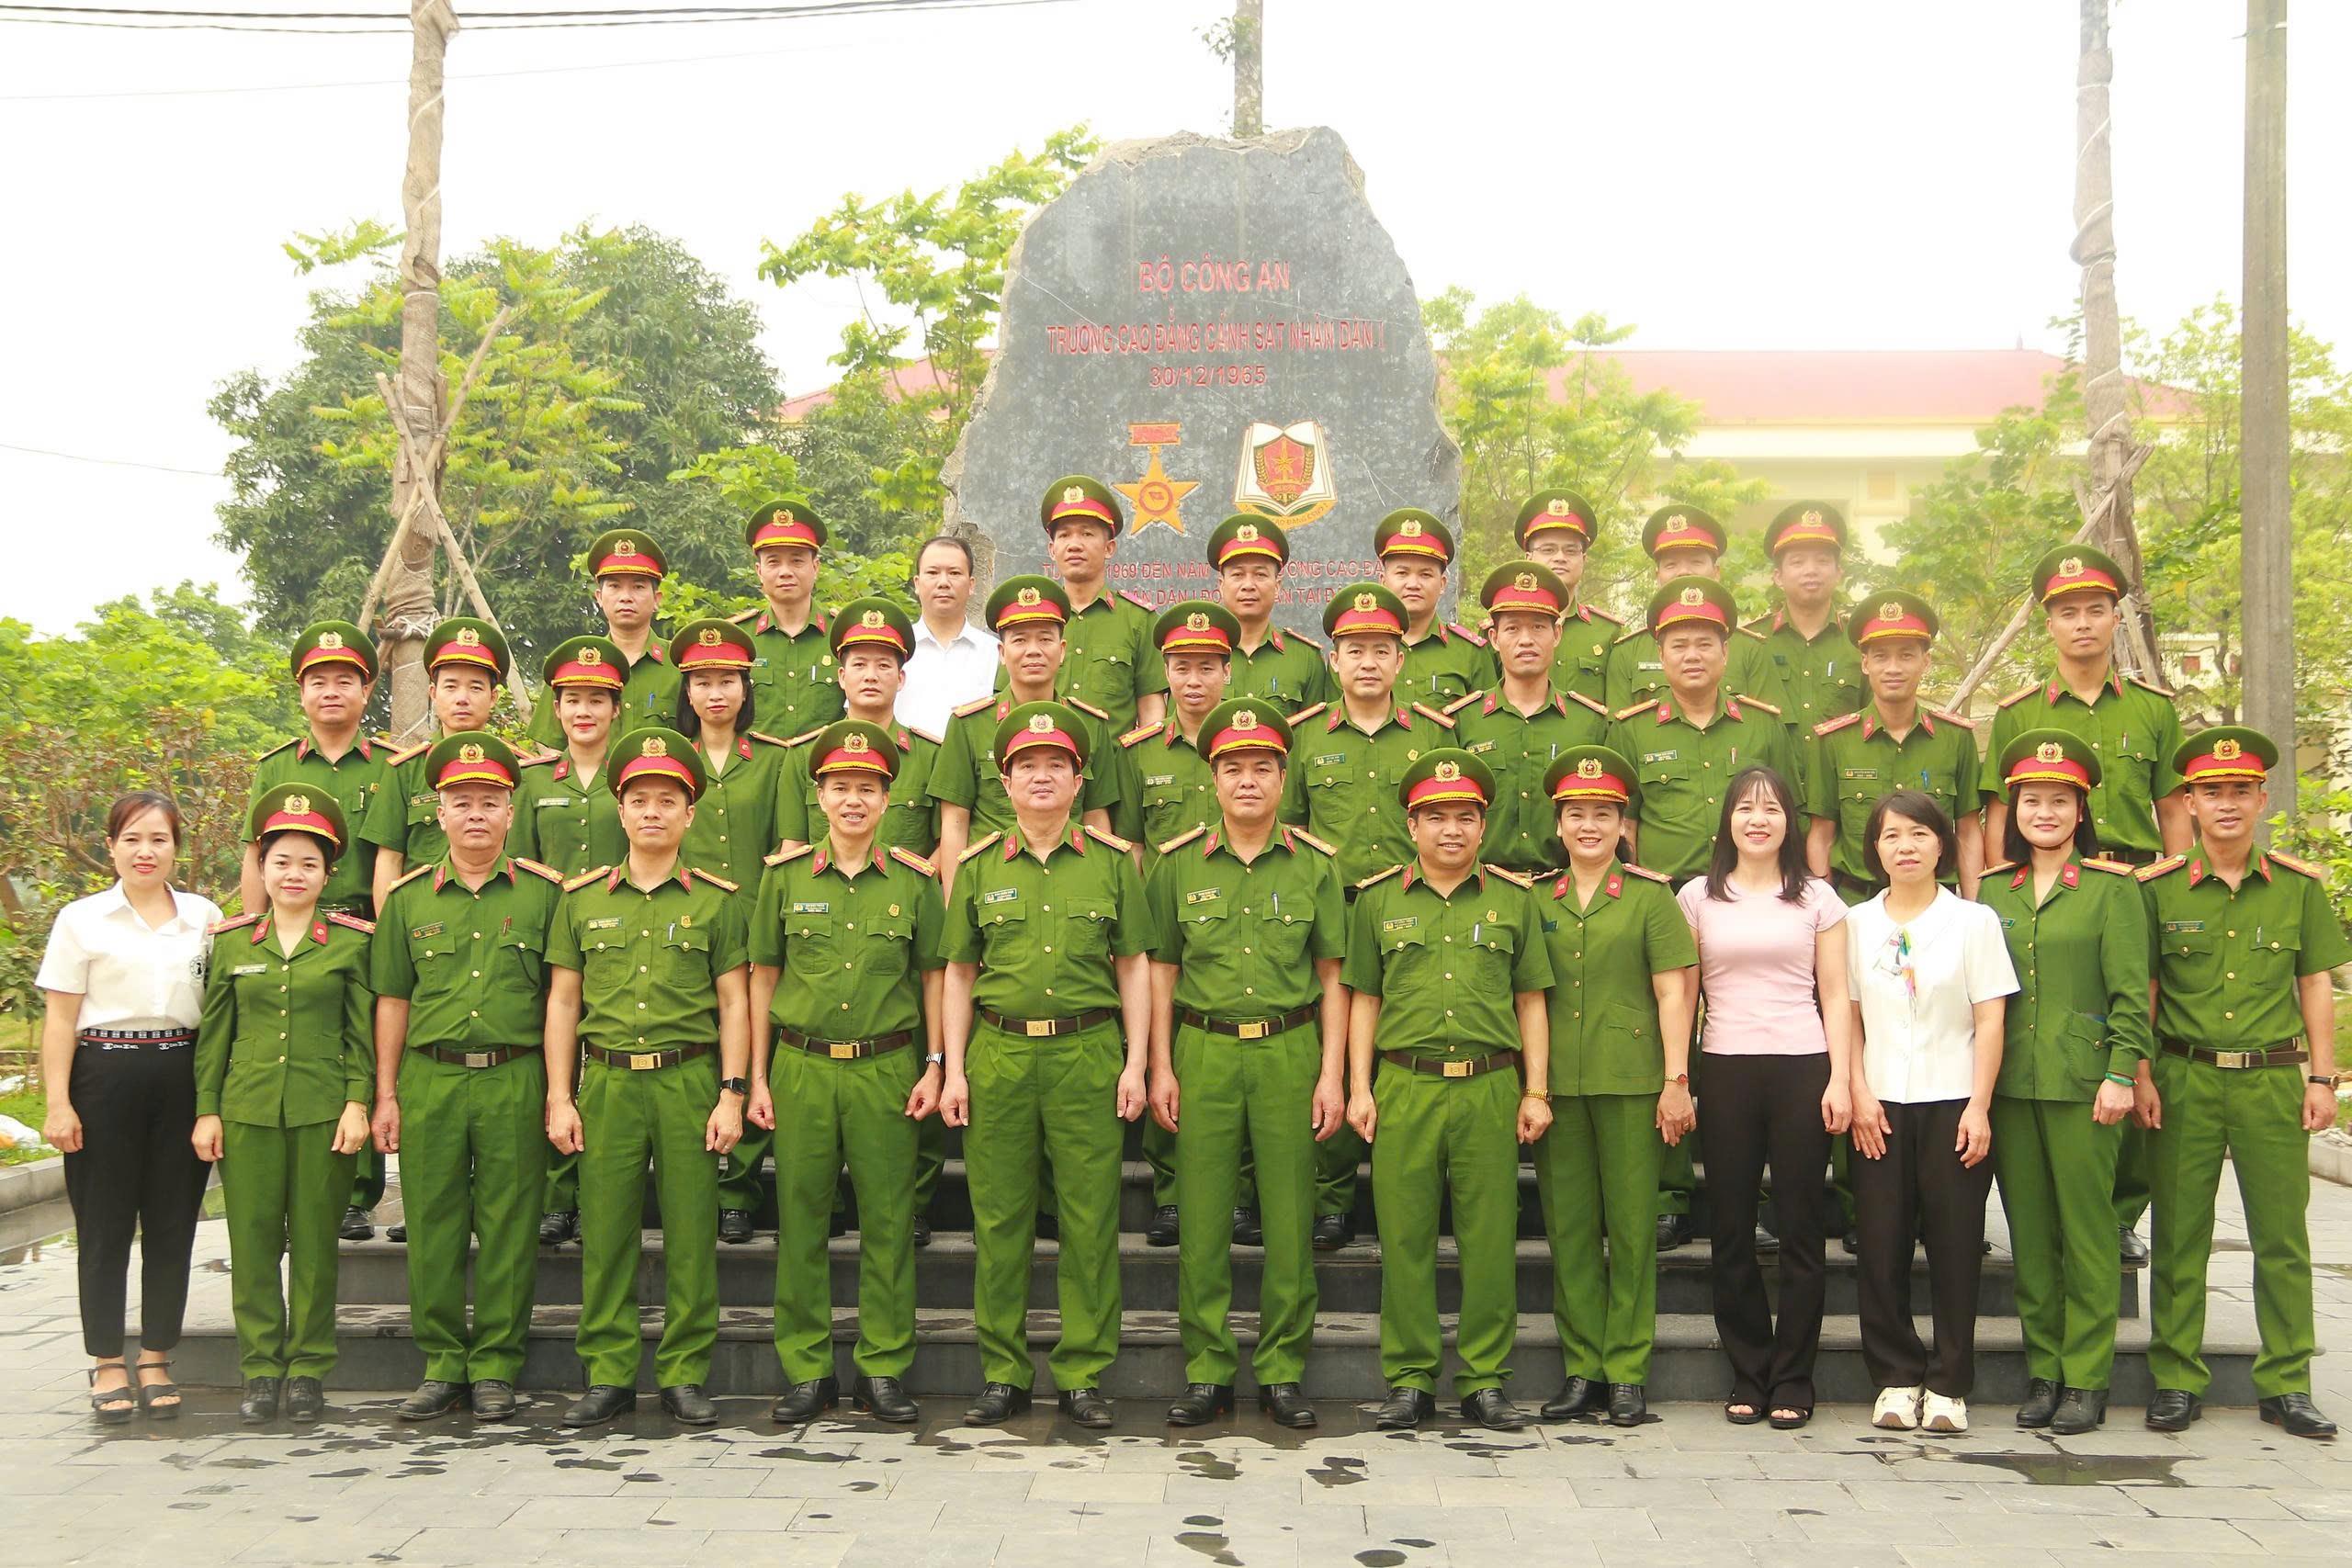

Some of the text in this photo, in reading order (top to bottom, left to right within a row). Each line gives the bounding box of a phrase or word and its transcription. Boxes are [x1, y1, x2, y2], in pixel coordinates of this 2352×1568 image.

[1139, 252, 1291, 300] BỘ CÔNG AN
[1117, 323, 1151, 355] CAO
[1204, 311, 1250, 353] CẢNH
[1253, 313, 1285, 351] SÁT
[1288, 312, 1335, 352] NHÂN
[1149, 364, 1267, 388] 30/12/1965
[1105, 562, 1137, 579] 1969
[1141, 558, 1172, 579] ĐẾN
[1176, 558, 1210, 579] NĂM
[1326, 559, 1358, 577] CAO
